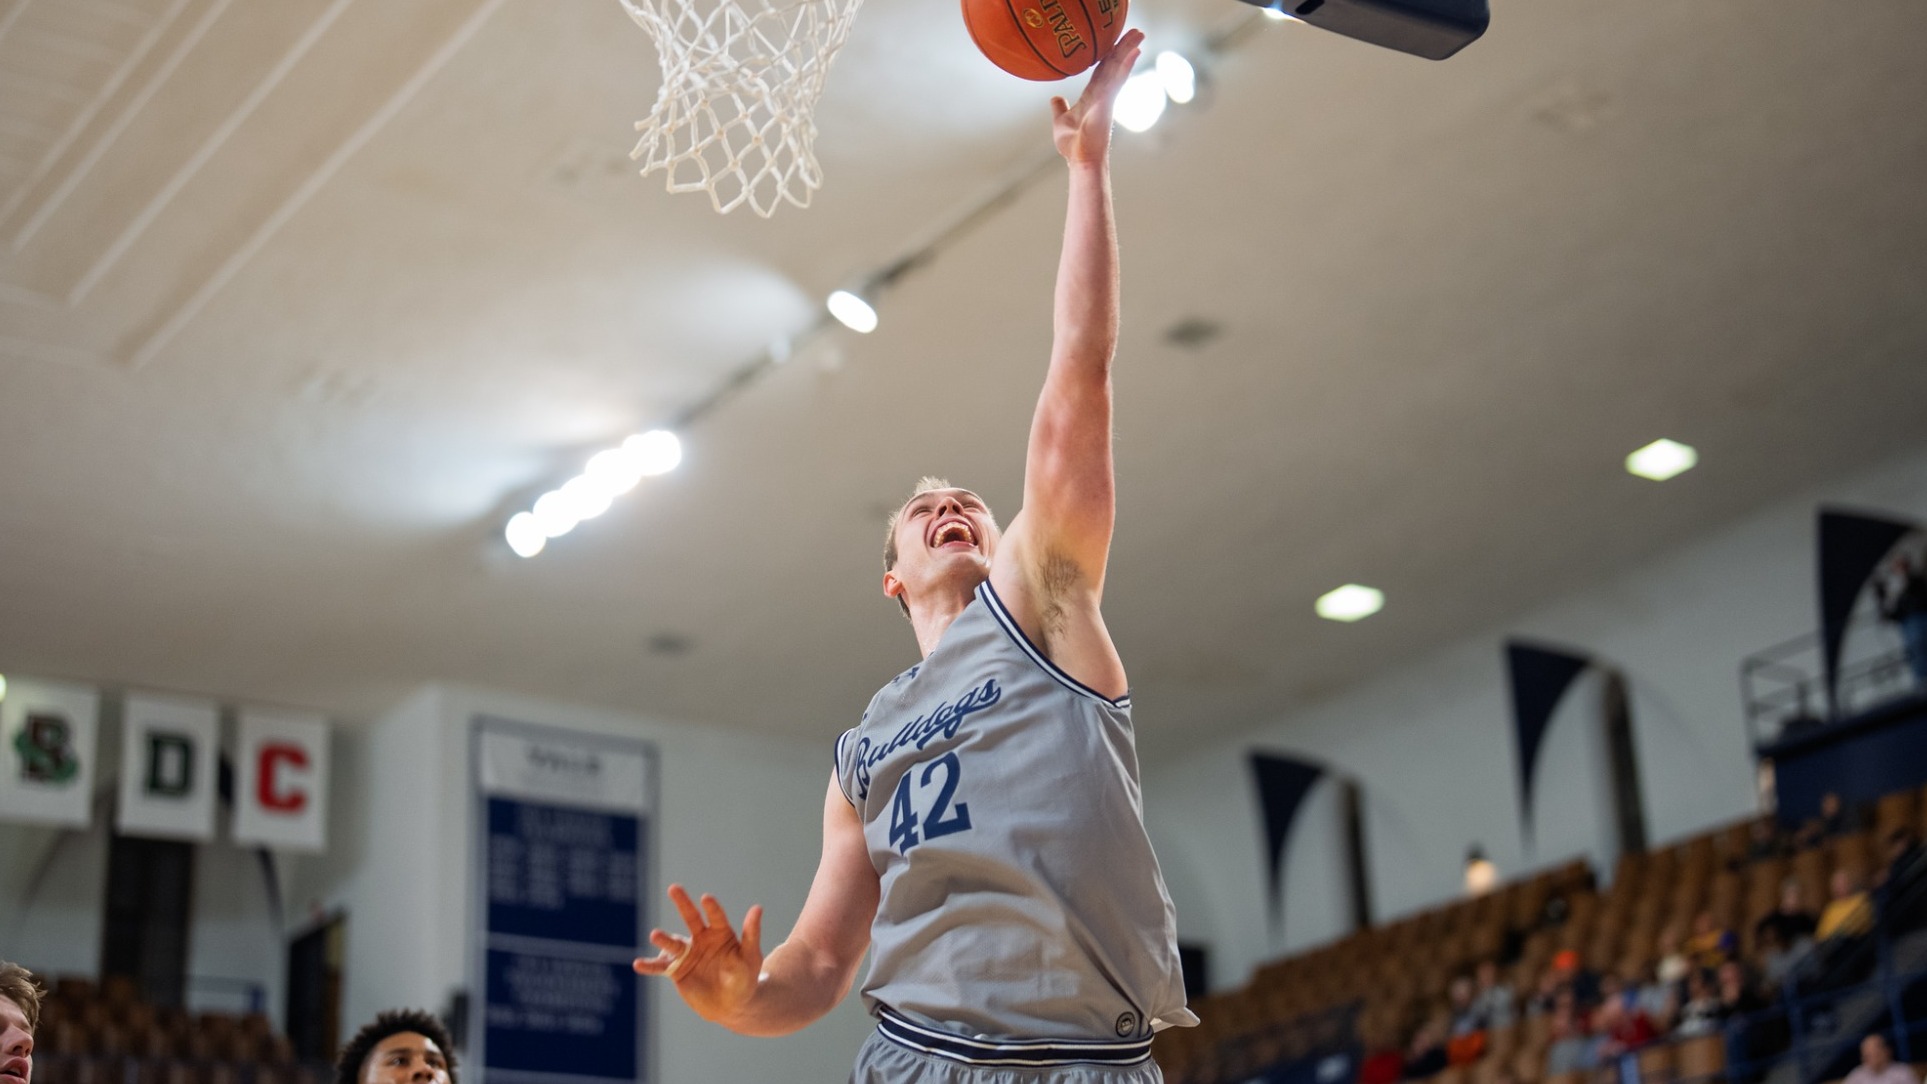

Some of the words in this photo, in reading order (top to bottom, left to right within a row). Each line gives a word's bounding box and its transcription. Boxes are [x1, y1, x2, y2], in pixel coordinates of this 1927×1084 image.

[145, 732, 194, 798] D
[256, 741, 311, 815] C
[856, 678, 1001, 801] Bulldogs
[889, 751, 972, 857] 42
